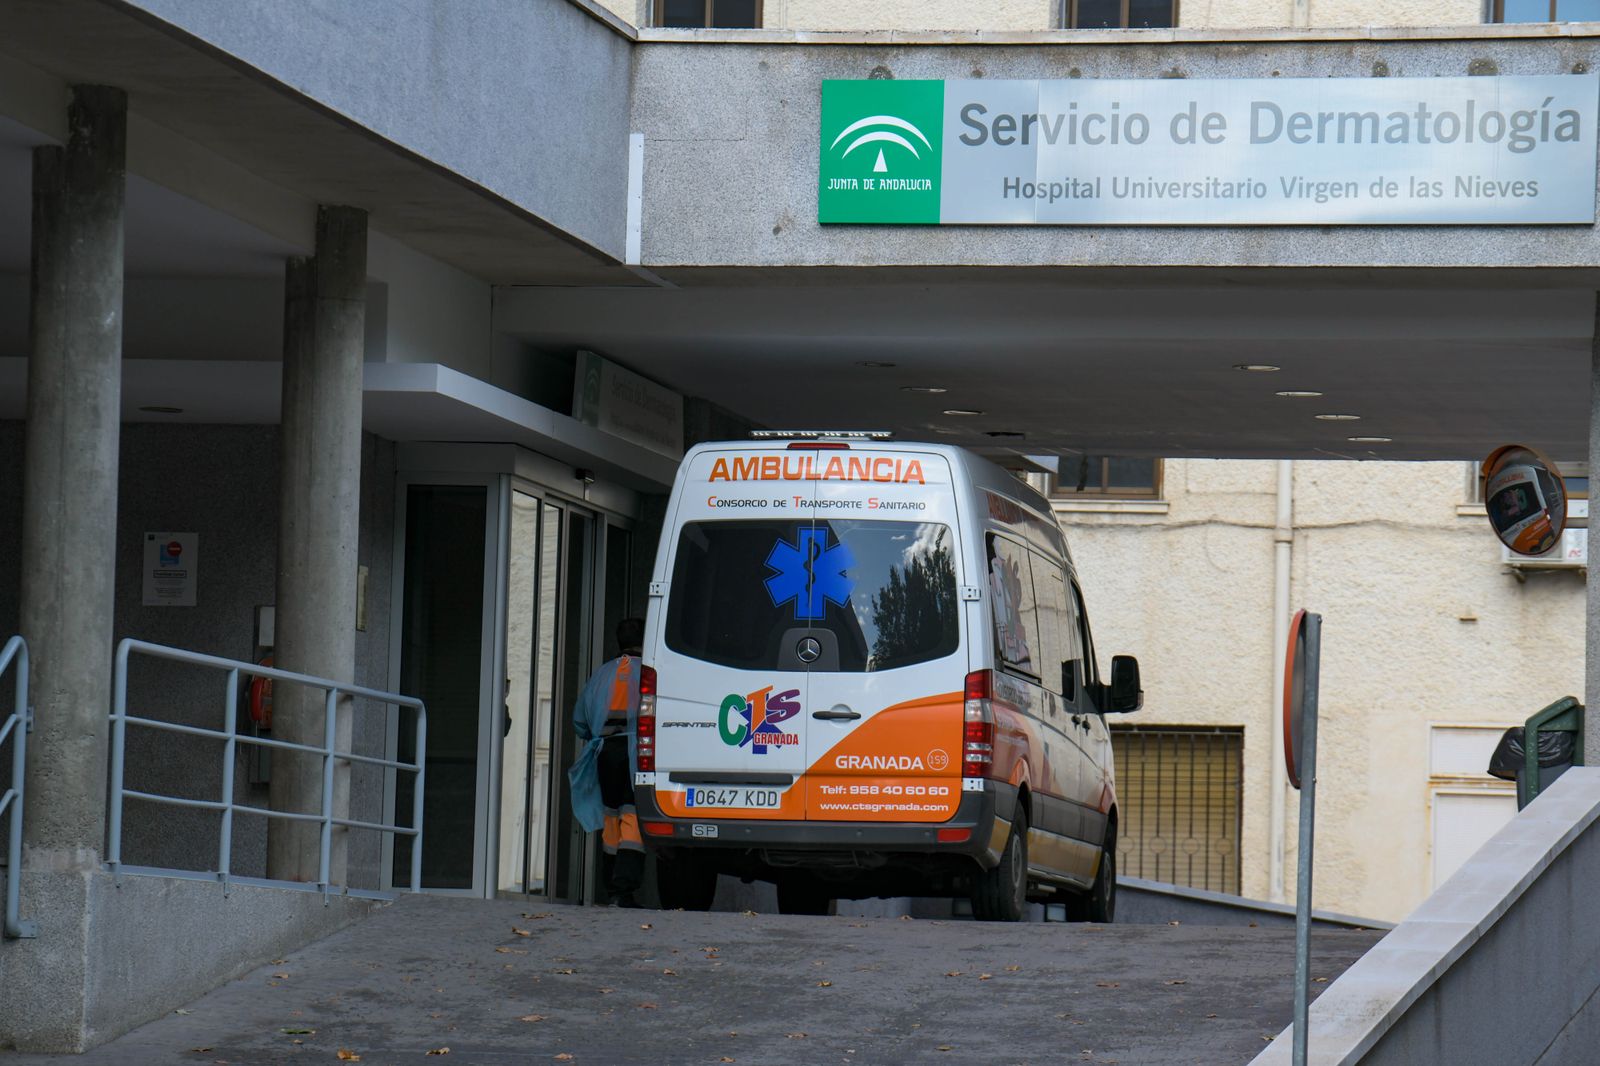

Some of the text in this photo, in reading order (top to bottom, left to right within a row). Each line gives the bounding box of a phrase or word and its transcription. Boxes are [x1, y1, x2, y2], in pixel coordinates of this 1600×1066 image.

[958, 96, 1582, 154] Servicio de Dermatología
[827, 178, 932, 190] JUNTA DE ANDALUCIA
[1002, 175, 1539, 204] Hospital Universitario Virgen de las Nieves
[708, 456, 925, 484] AMBULANCIA
[718, 685, 801, 746] CTS
[753, 733, 799, 745] GRANADA
[835, 755, 924, 770] GRANADA
[695, 789, 778, 807] 0647 KDD
[820, 785, 949, 796] Telf: 958 40 60 60
[820, 802, 949, 813] www.ctsgranada.com
[694, 826, 717, 836] SP
